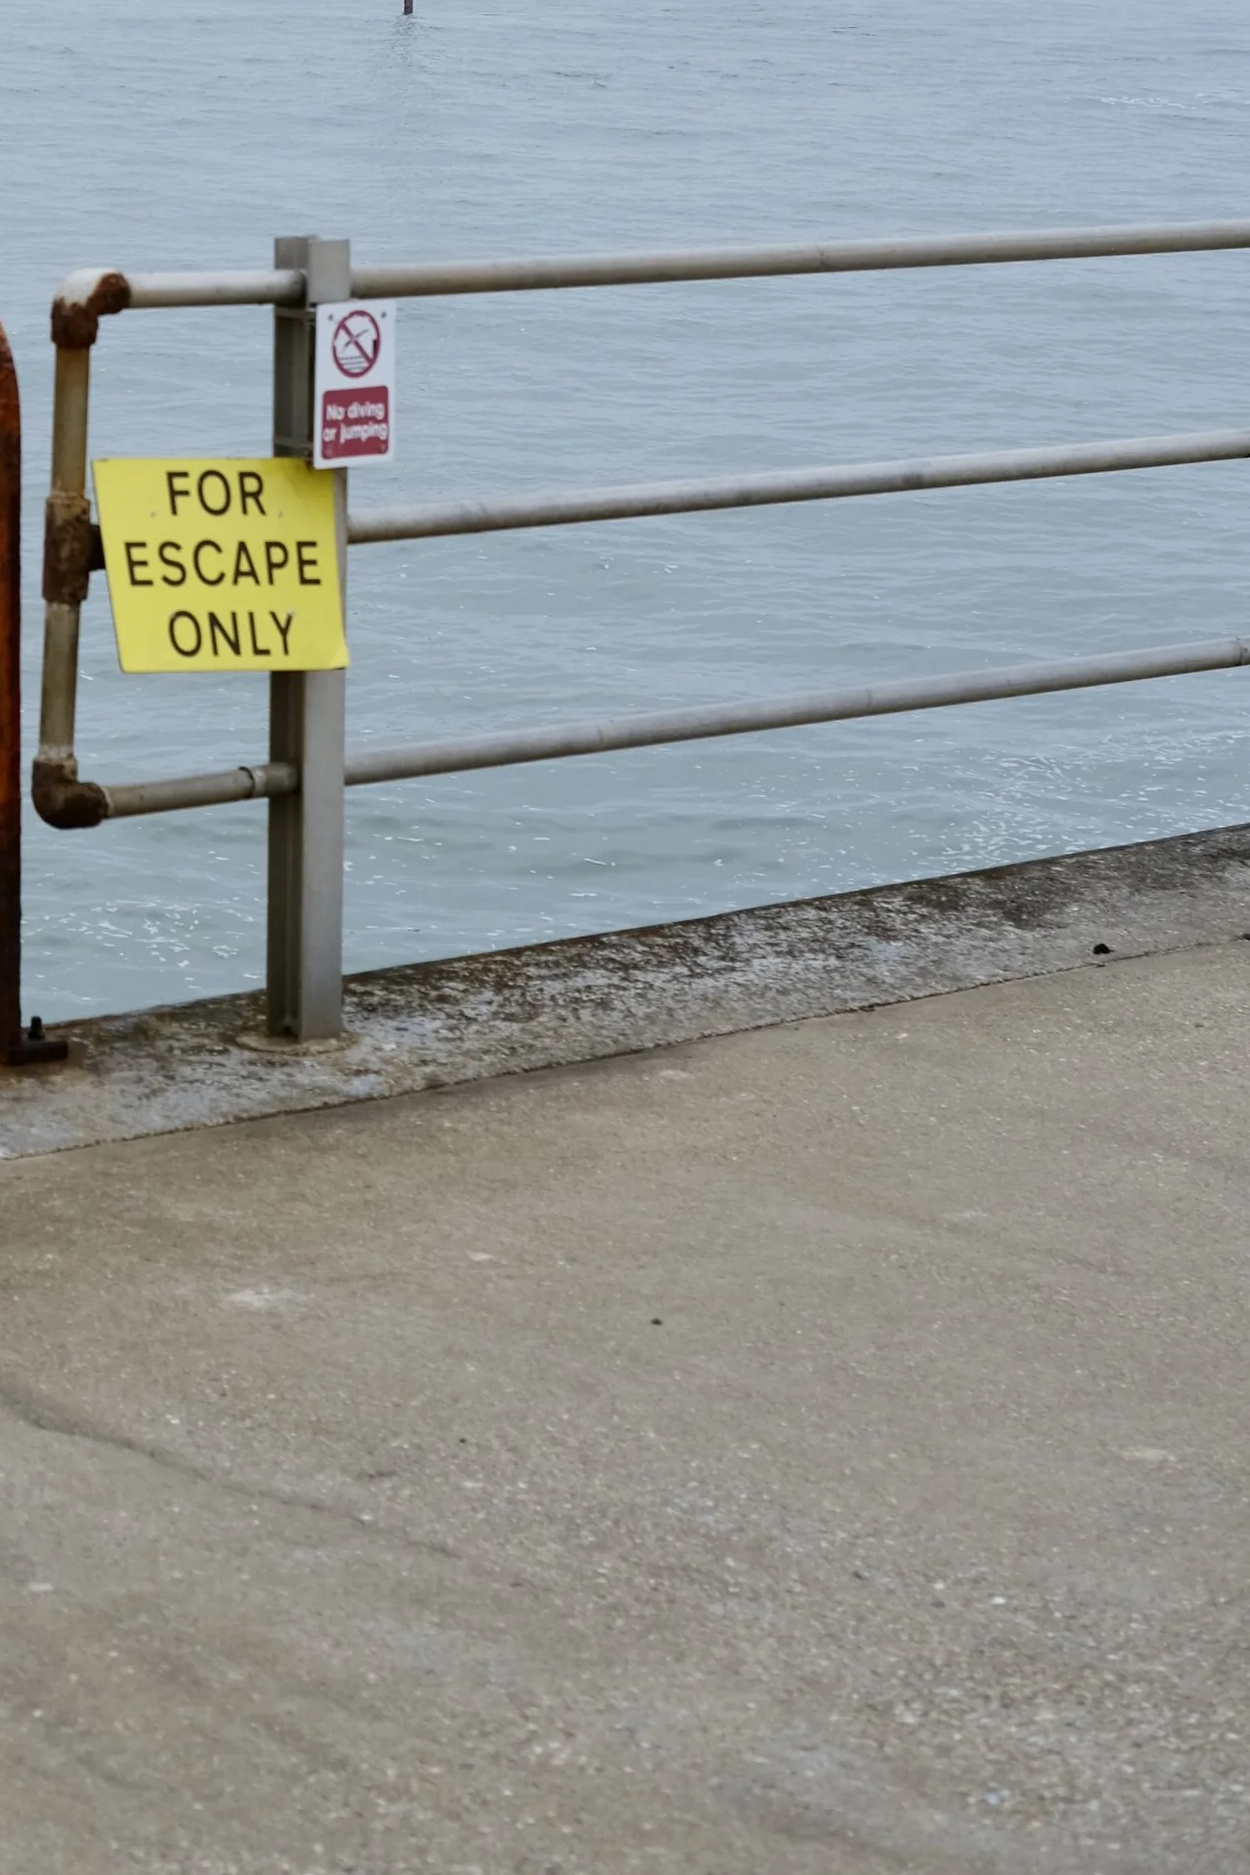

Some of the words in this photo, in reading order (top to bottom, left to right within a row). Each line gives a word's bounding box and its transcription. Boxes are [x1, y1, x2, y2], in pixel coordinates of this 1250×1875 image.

[323, 426, 337, 442] or
[339, 421, 388, 444] jumping
[326, 404, 345, 421] No
[347, 400, 385, 420] diving
[166, 469, 266, 516] FOR
[124, 539, 322, 587] ESCAPE
[168, 610, 295, 657] ONLY
